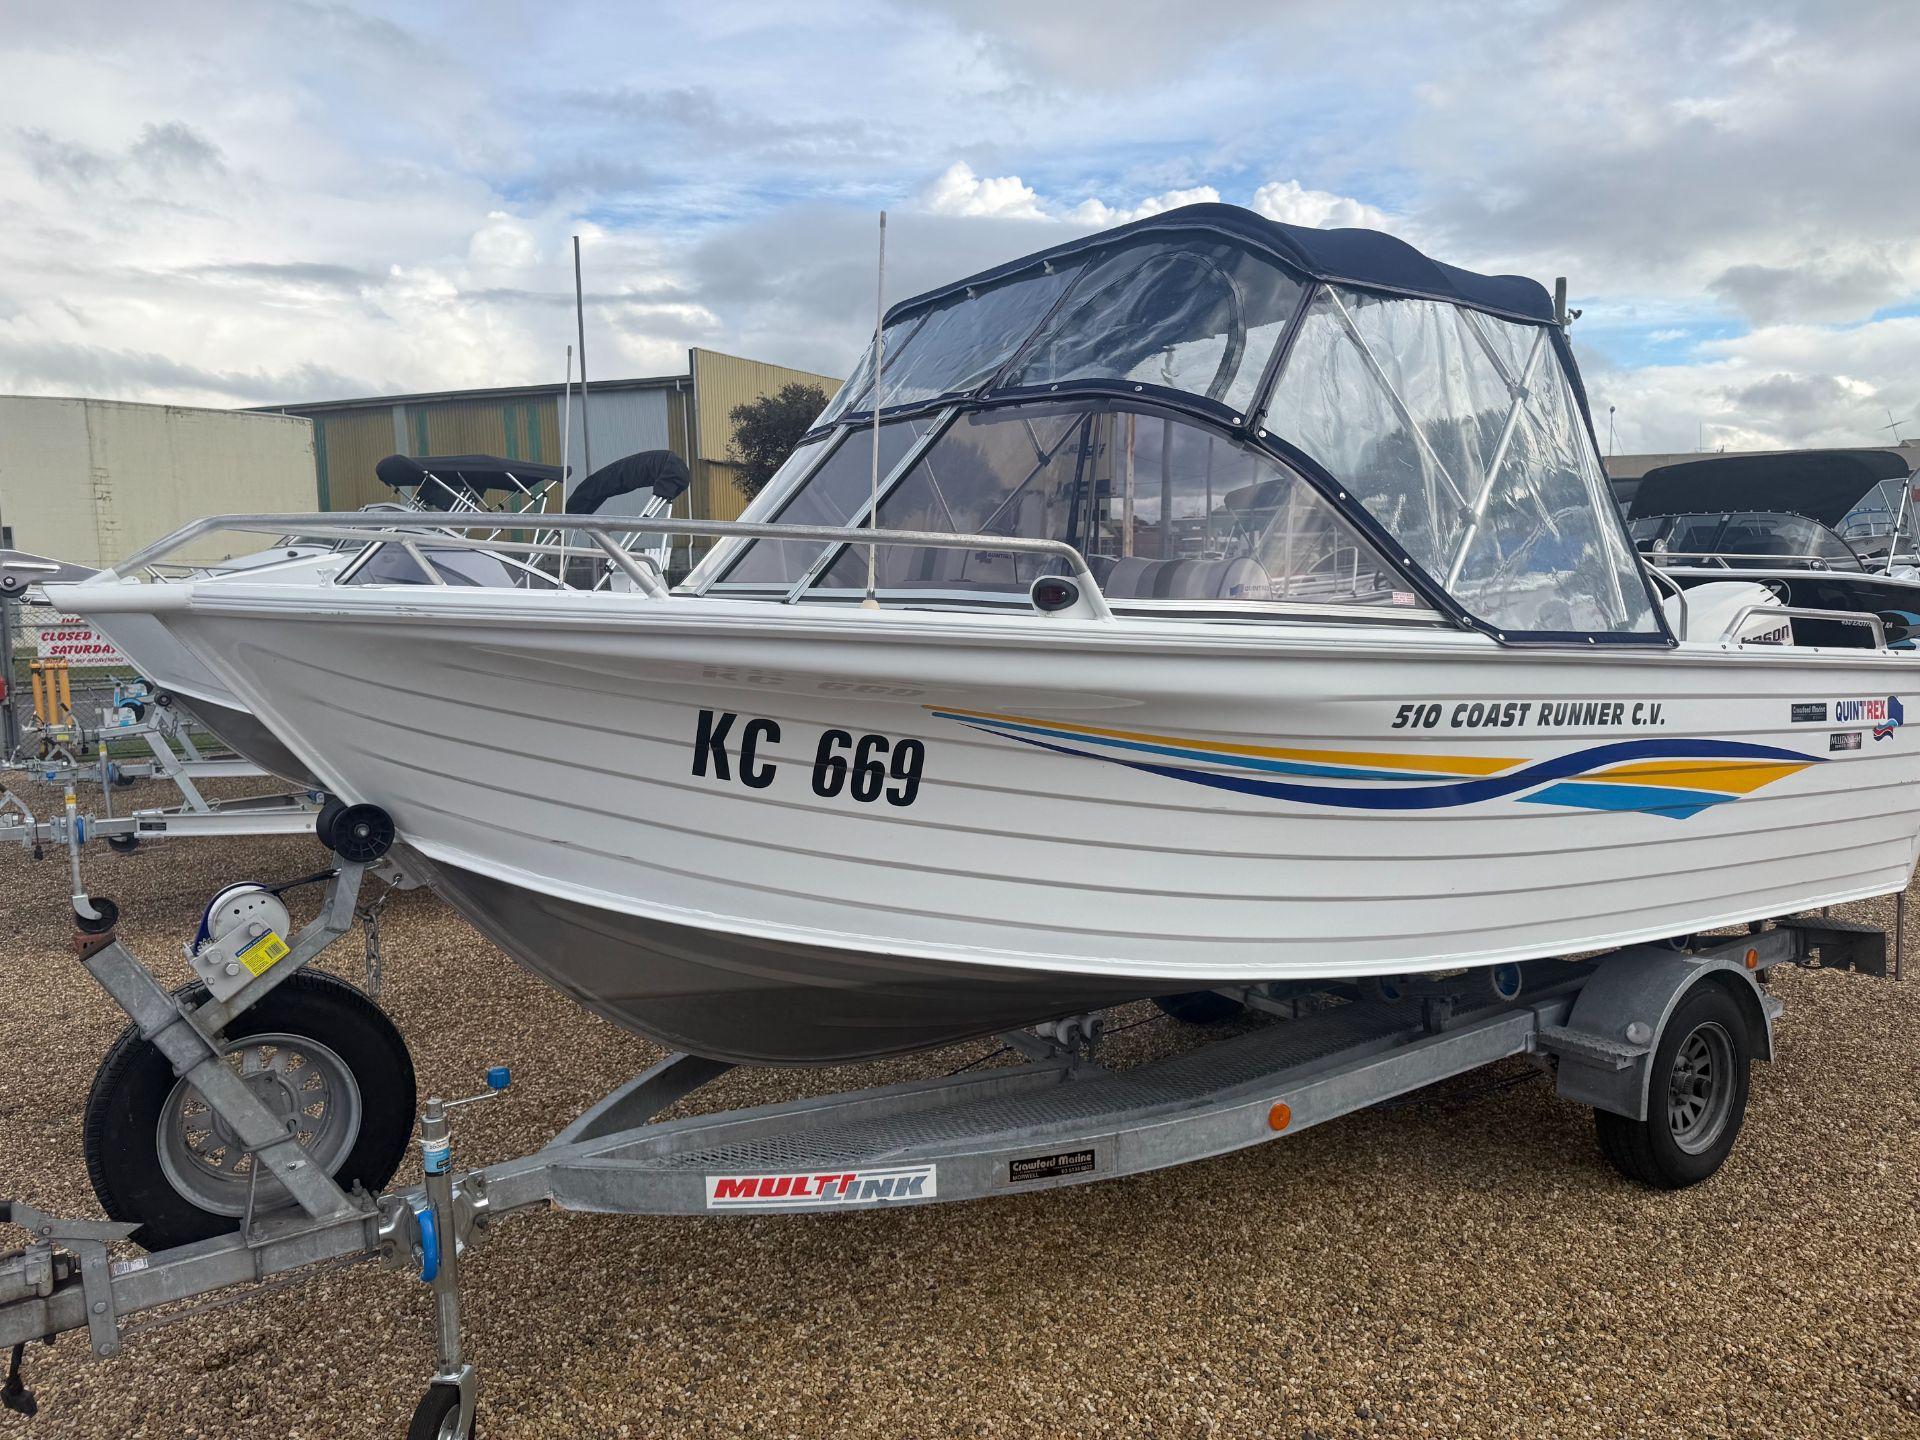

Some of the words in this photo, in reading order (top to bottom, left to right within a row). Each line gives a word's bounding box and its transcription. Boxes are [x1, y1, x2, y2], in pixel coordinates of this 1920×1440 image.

[41, 631, 92, 642] CLOSED
[1391, 703, 1443, 729] 510
[1450, 702, 1532, 728] COAST
[1537, 702, 1625, 726] RUNNER
[1632, 702, 1666, 726] C.V.
[1836, 700, 1886, 721] QUINTREX
[692, 709, 781, 788] KC
[811, 729, 925, 807] 669
[1013, 1157, 1056, 1171] Crawford
[1058, 1154, 1092, 1165] Marine
[1012, 1172, 1040, 1181] MORWELL
